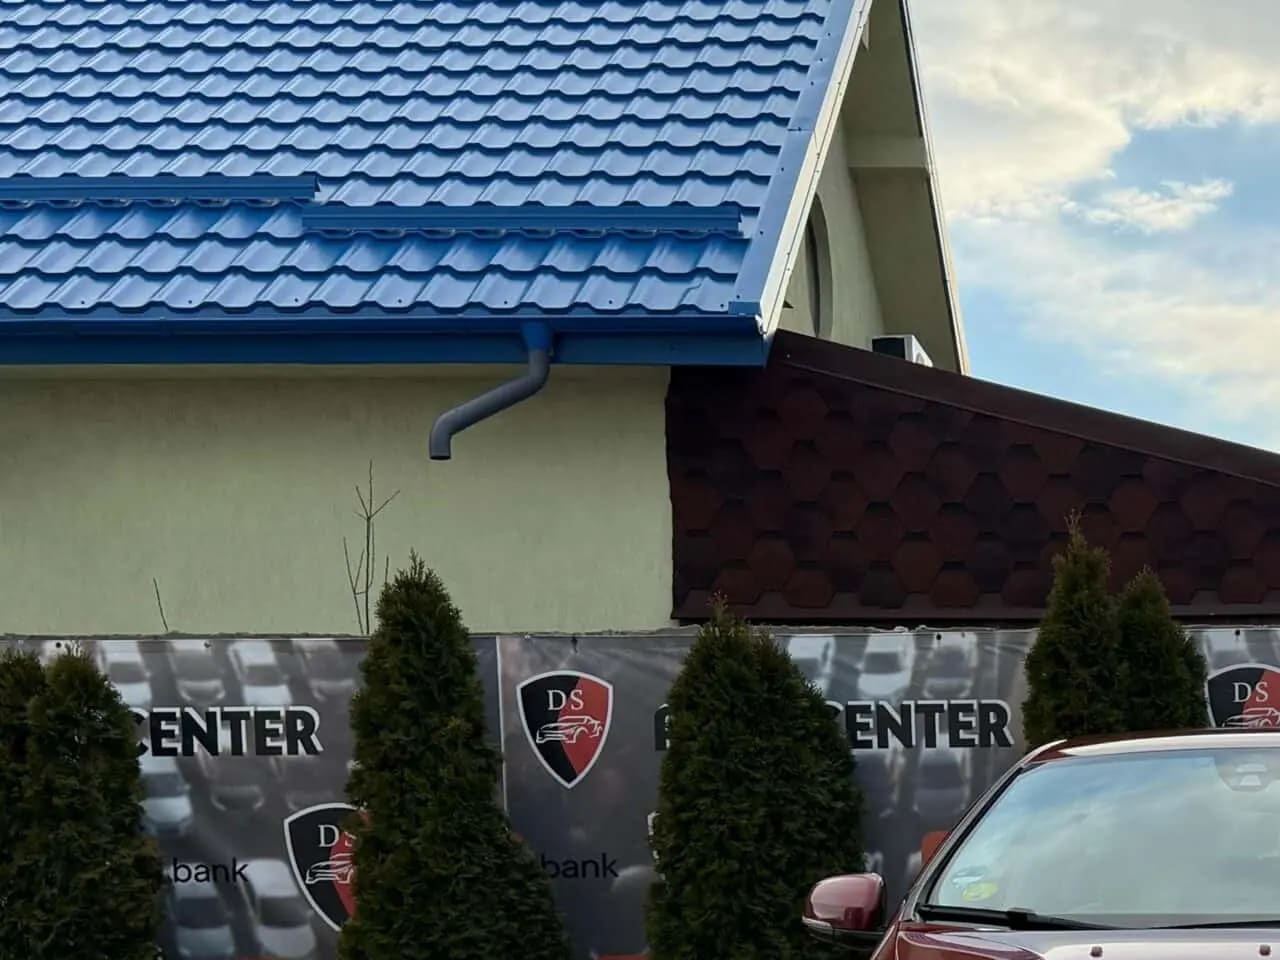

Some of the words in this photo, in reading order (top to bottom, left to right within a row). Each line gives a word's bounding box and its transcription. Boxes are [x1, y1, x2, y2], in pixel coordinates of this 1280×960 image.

[547, 689, 585, 711] DS
[1231, 681, 1269, 703] DS
[825, 699, 1015, 749] ENTER
[172, 857, 249, 884] bank
